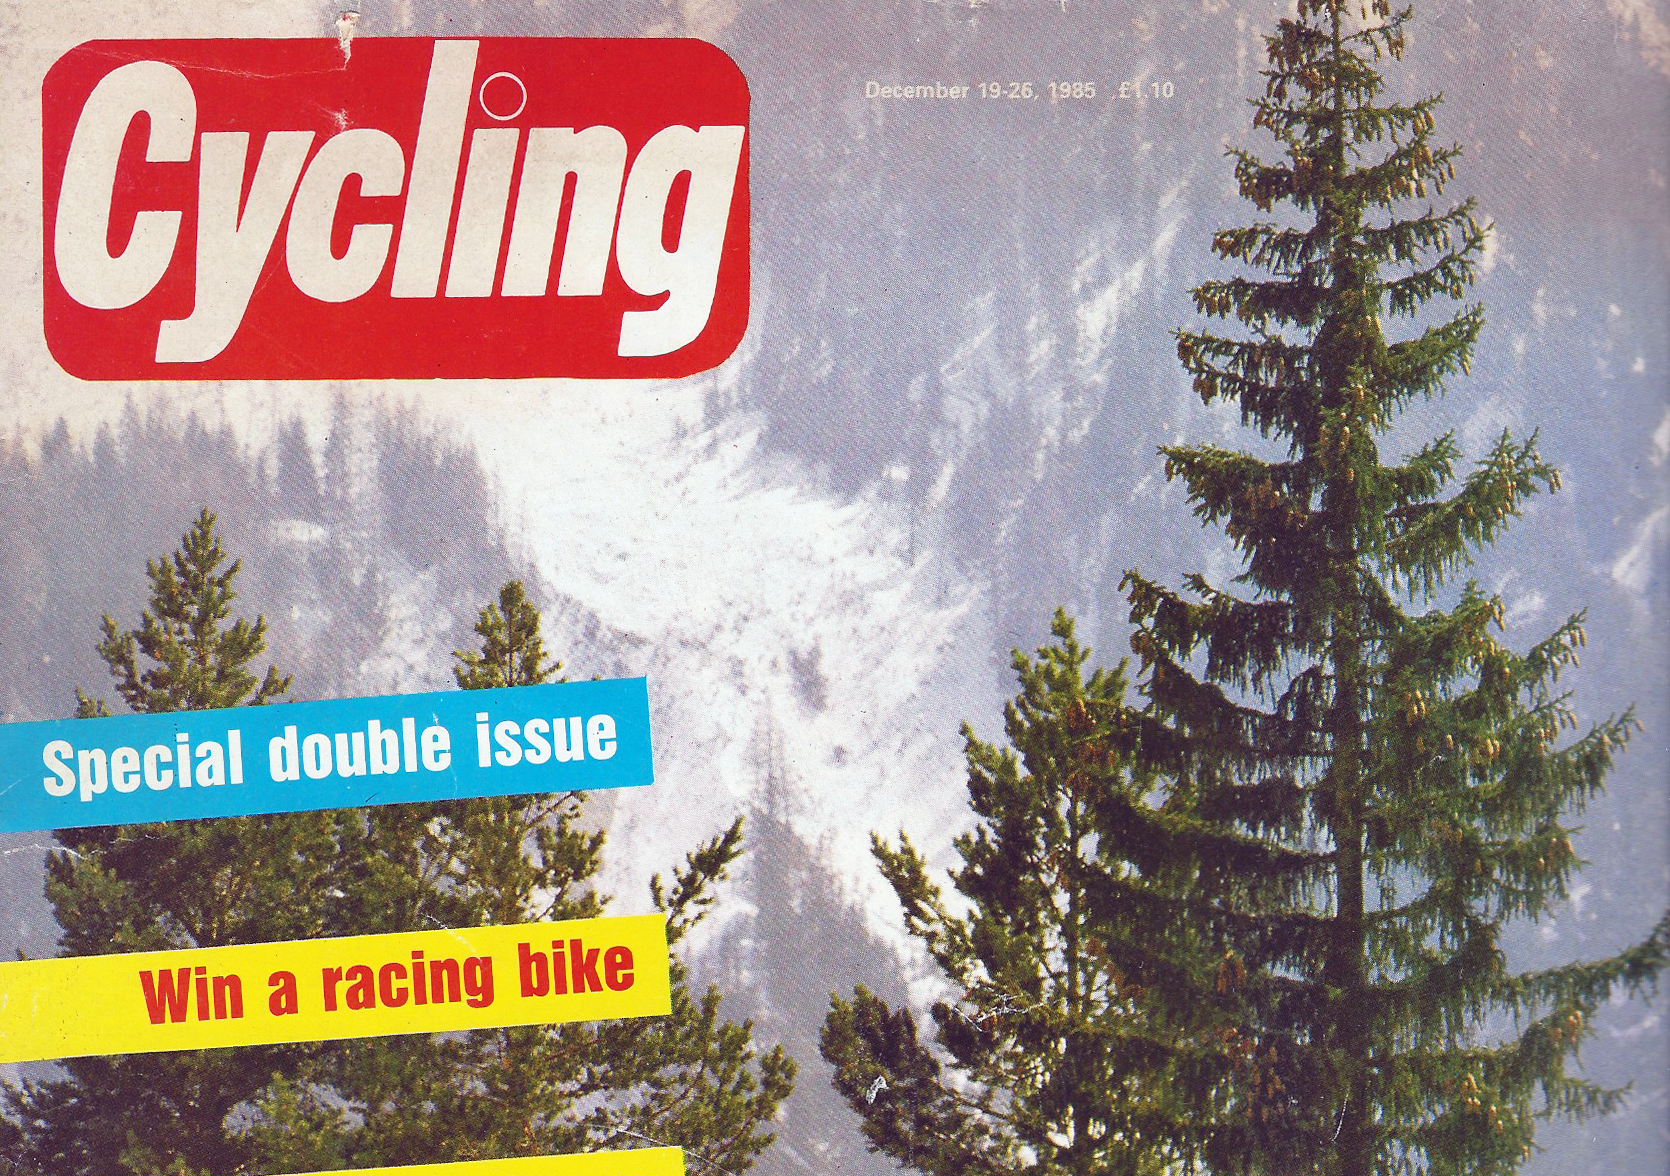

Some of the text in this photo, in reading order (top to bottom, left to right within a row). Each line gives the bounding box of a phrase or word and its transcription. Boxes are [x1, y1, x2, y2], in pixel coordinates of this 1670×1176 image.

[865, 81, 1175, 101] December 19-26, 1985 £1.10
[53, 38, 747, 364] Cycling
[42, 711, 619, 802] Special double issue
[139, 938, 635, 1025] Win a racing bike
